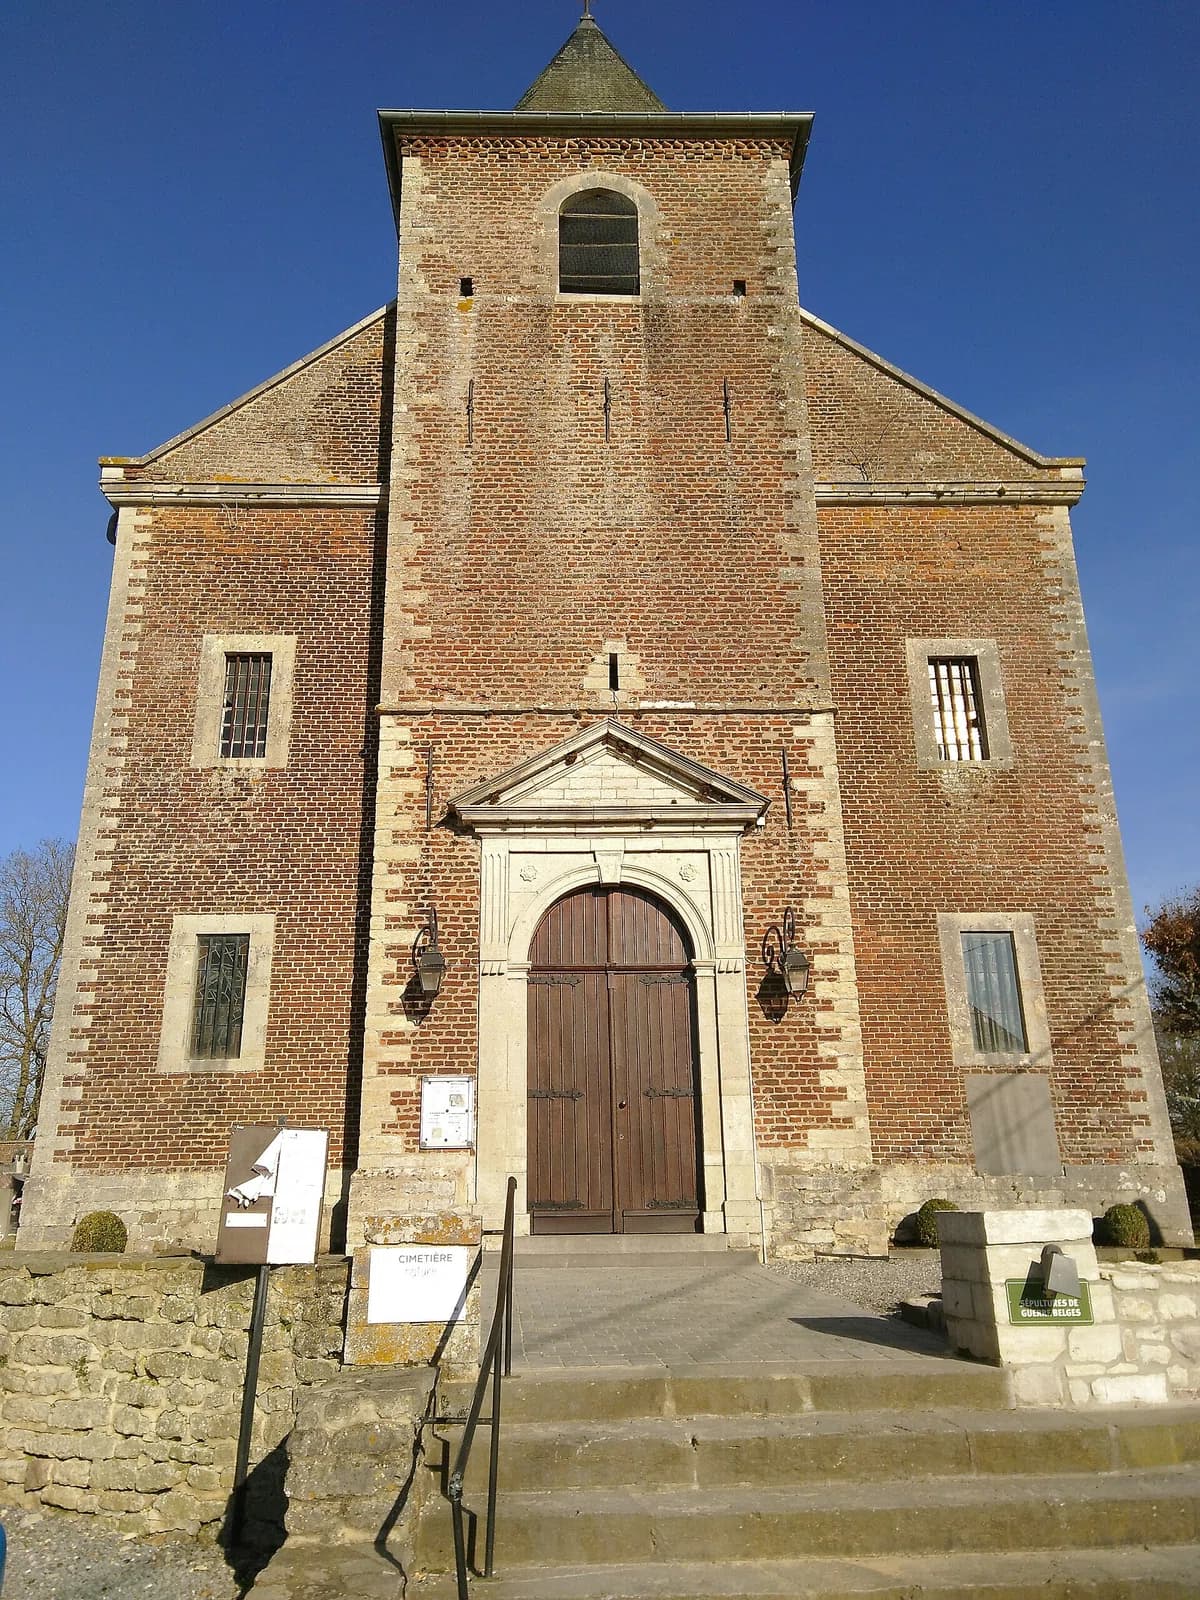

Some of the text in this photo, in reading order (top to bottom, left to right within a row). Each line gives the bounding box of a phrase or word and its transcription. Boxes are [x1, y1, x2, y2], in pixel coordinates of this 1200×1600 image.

[398, 1252, 453, 1264] CIMETIÈRE
[1019, 1298, 1079, 1308] SÉPULTURES DE
[1053, 1309, 1082, 1317] BELGES
